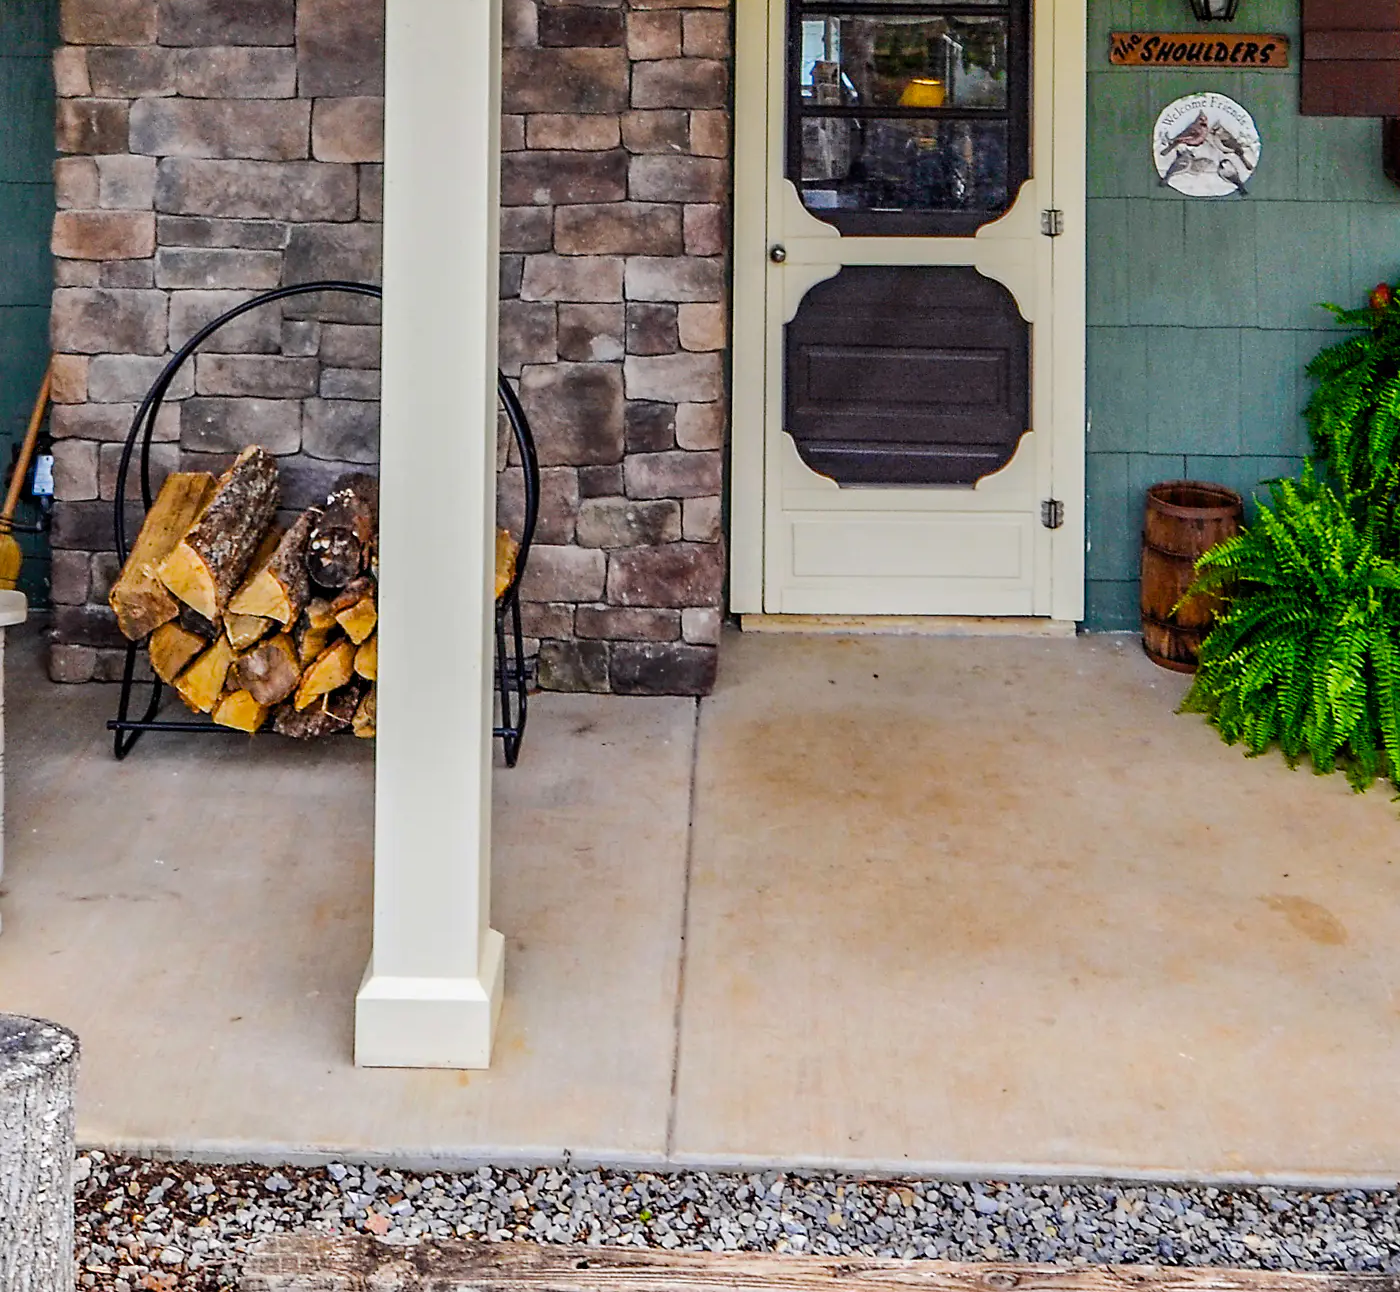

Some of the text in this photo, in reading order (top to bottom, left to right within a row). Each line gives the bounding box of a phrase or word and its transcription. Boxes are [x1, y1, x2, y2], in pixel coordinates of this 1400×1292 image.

[1140, 37, 1275, 62] SHOULDERS
[1162, 96, 1246, 126] Welcome Friends
